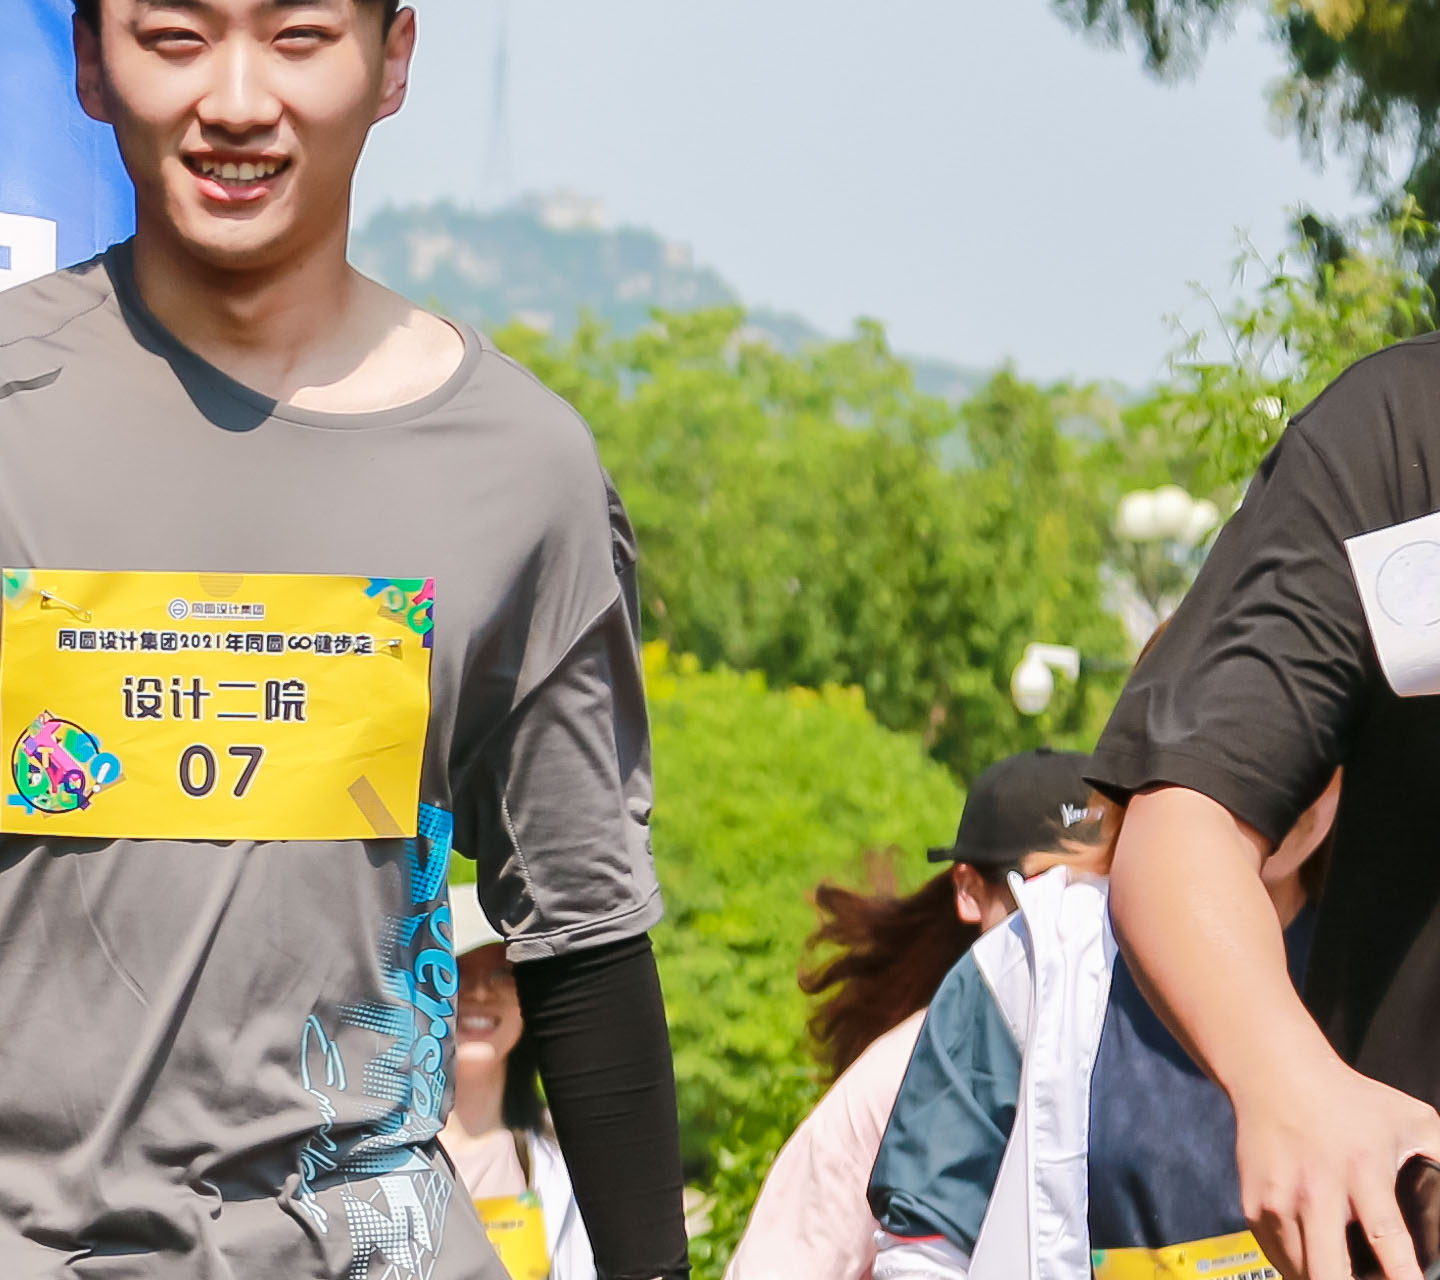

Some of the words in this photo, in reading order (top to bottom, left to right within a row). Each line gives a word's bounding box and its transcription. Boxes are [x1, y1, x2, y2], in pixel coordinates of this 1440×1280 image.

[122, 677, 307, 722] 设计二院
[179, 746, 265, 798] 07
